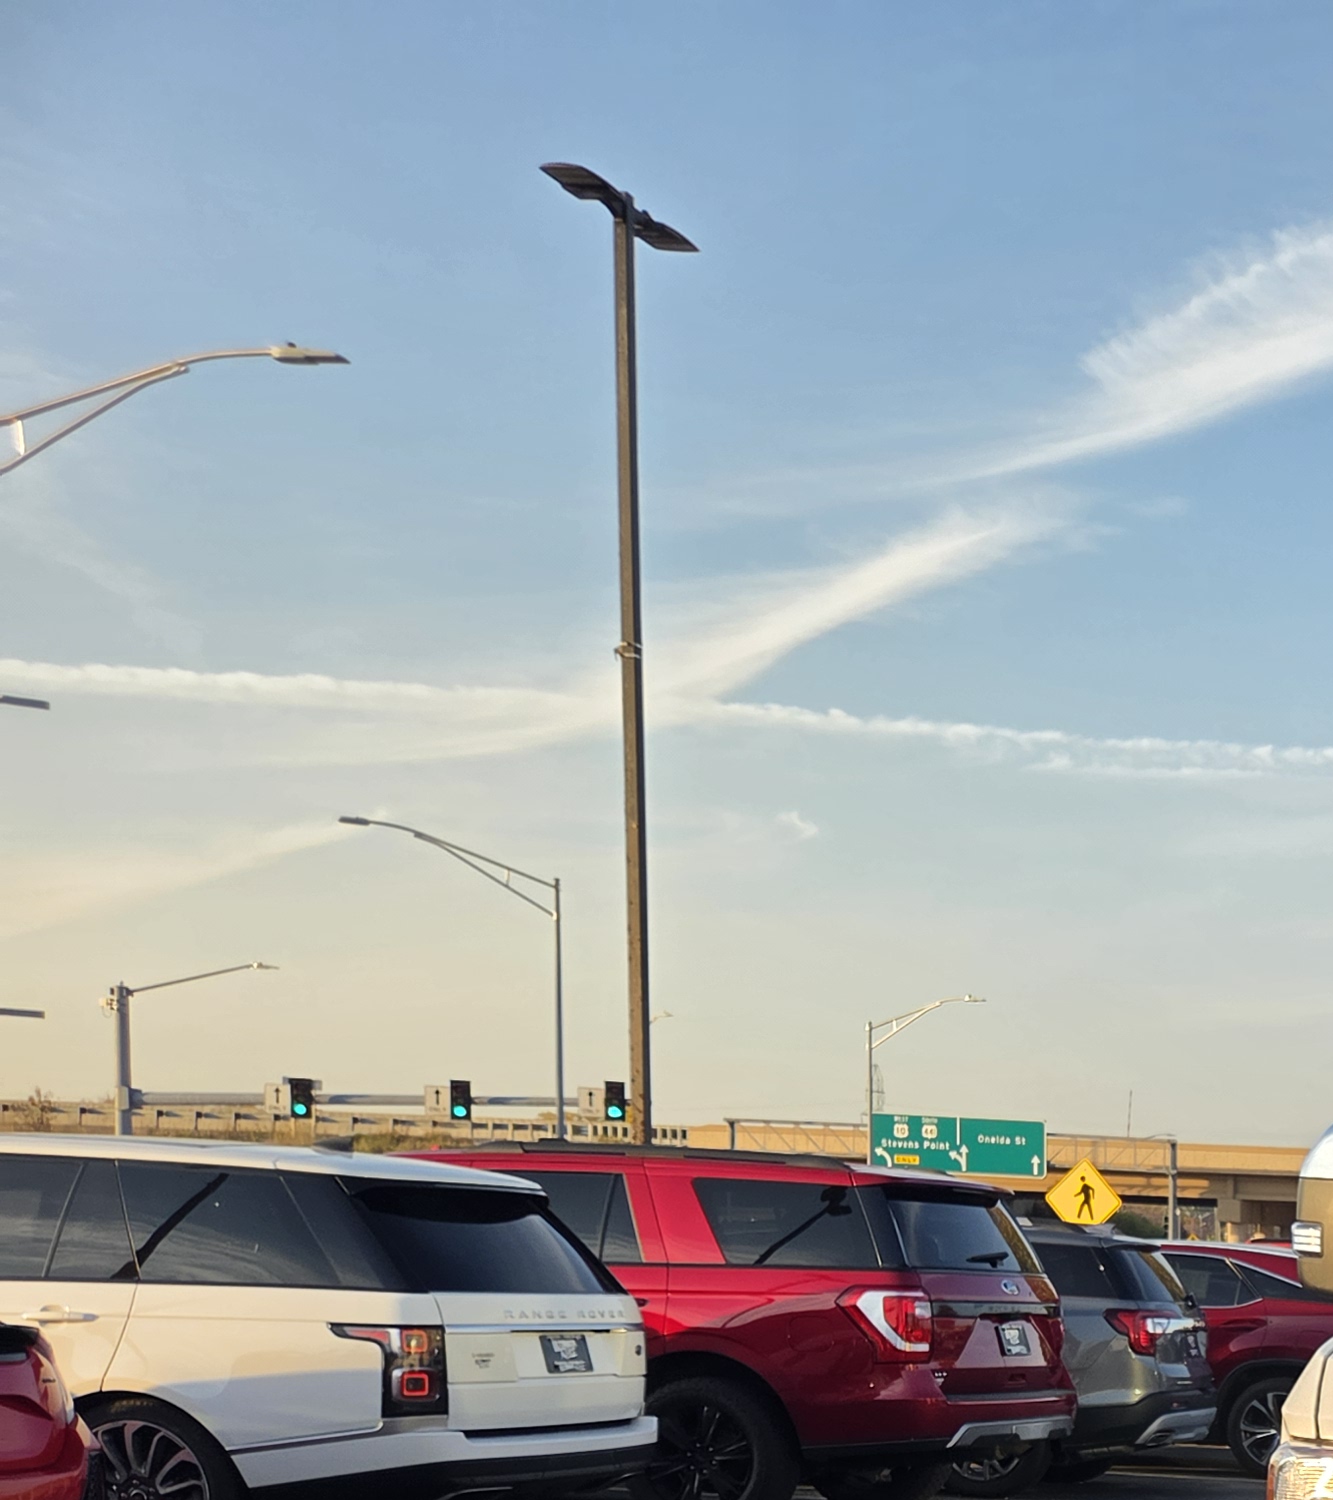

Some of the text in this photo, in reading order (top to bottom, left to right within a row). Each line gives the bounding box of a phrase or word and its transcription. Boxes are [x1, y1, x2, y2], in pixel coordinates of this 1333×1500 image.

[896, 1127, 906, 1135] 10
[881, 1138, 950, 1151] Stevens Point
[977, 1133, 1026, 1146] Oneida St
[503, 1309, 626, 1319] RANGE ROVER
